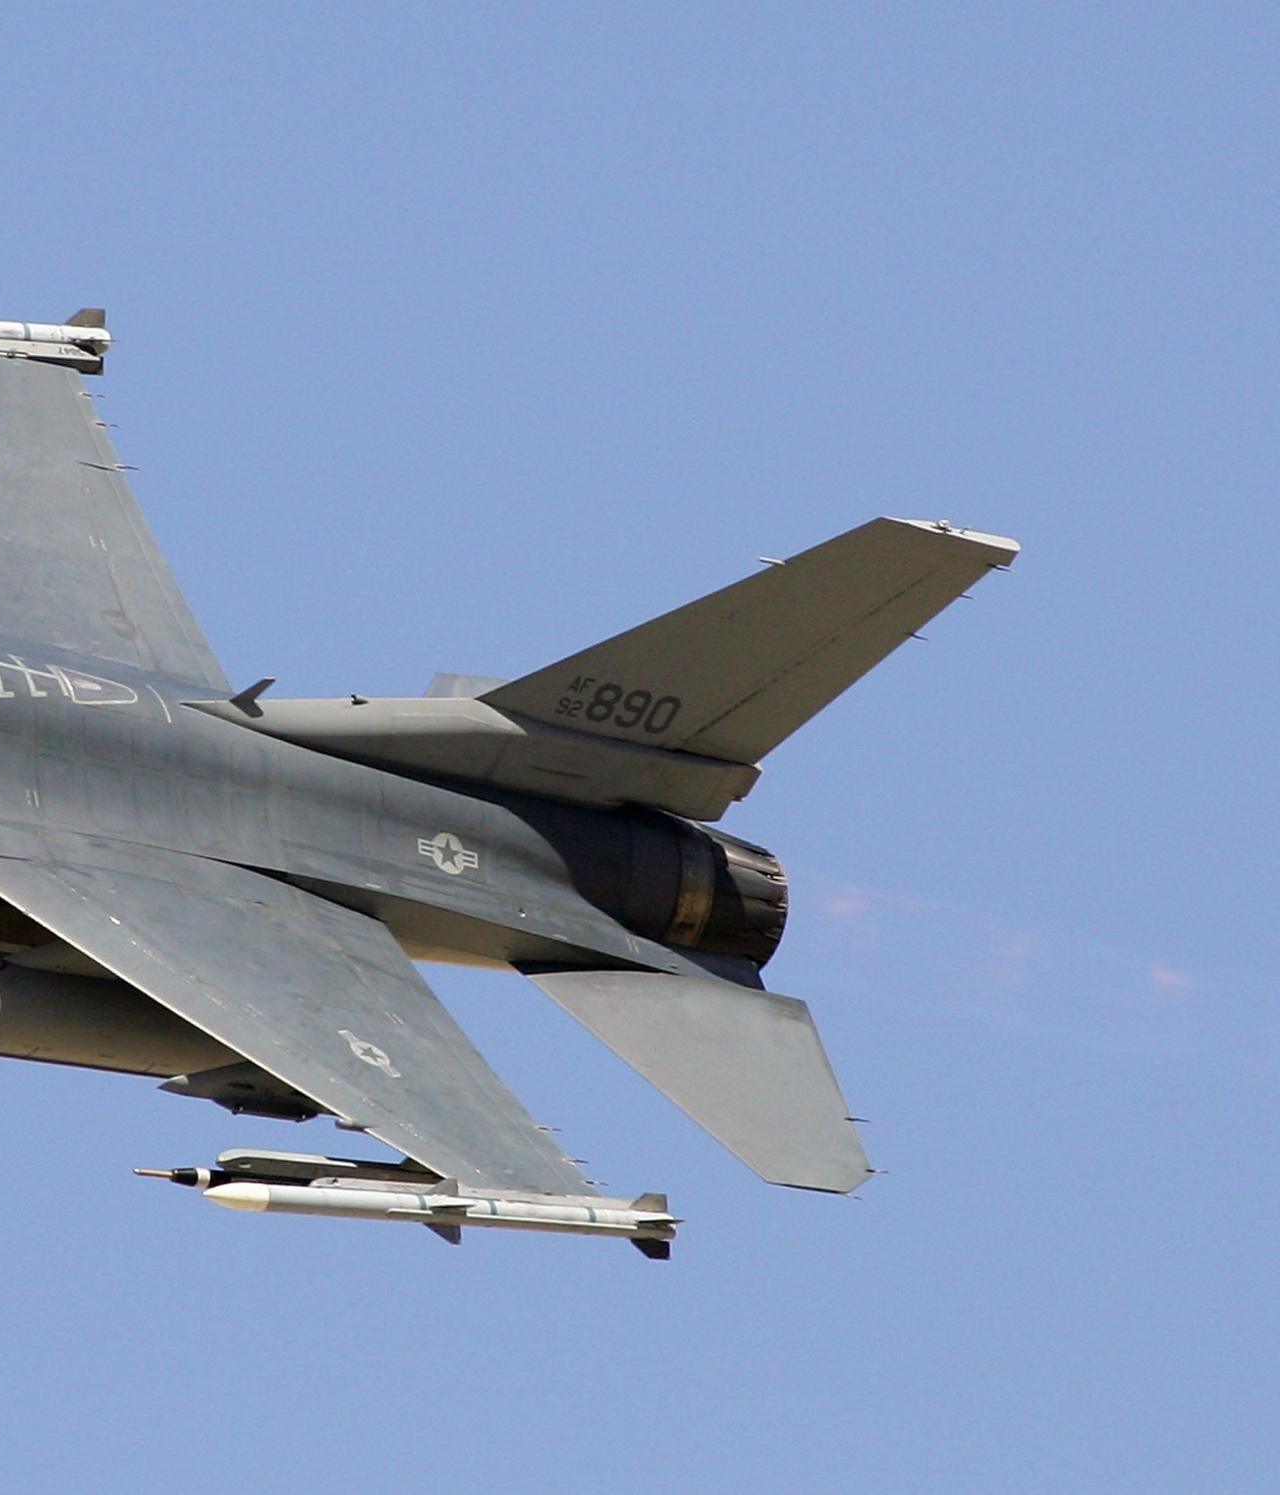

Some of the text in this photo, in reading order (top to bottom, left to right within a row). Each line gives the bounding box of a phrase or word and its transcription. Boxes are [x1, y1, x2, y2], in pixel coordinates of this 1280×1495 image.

[569, 675, 596, 693] AF
[556, 698, 583, 718] 92
[585, 683, 681, 734] 890
